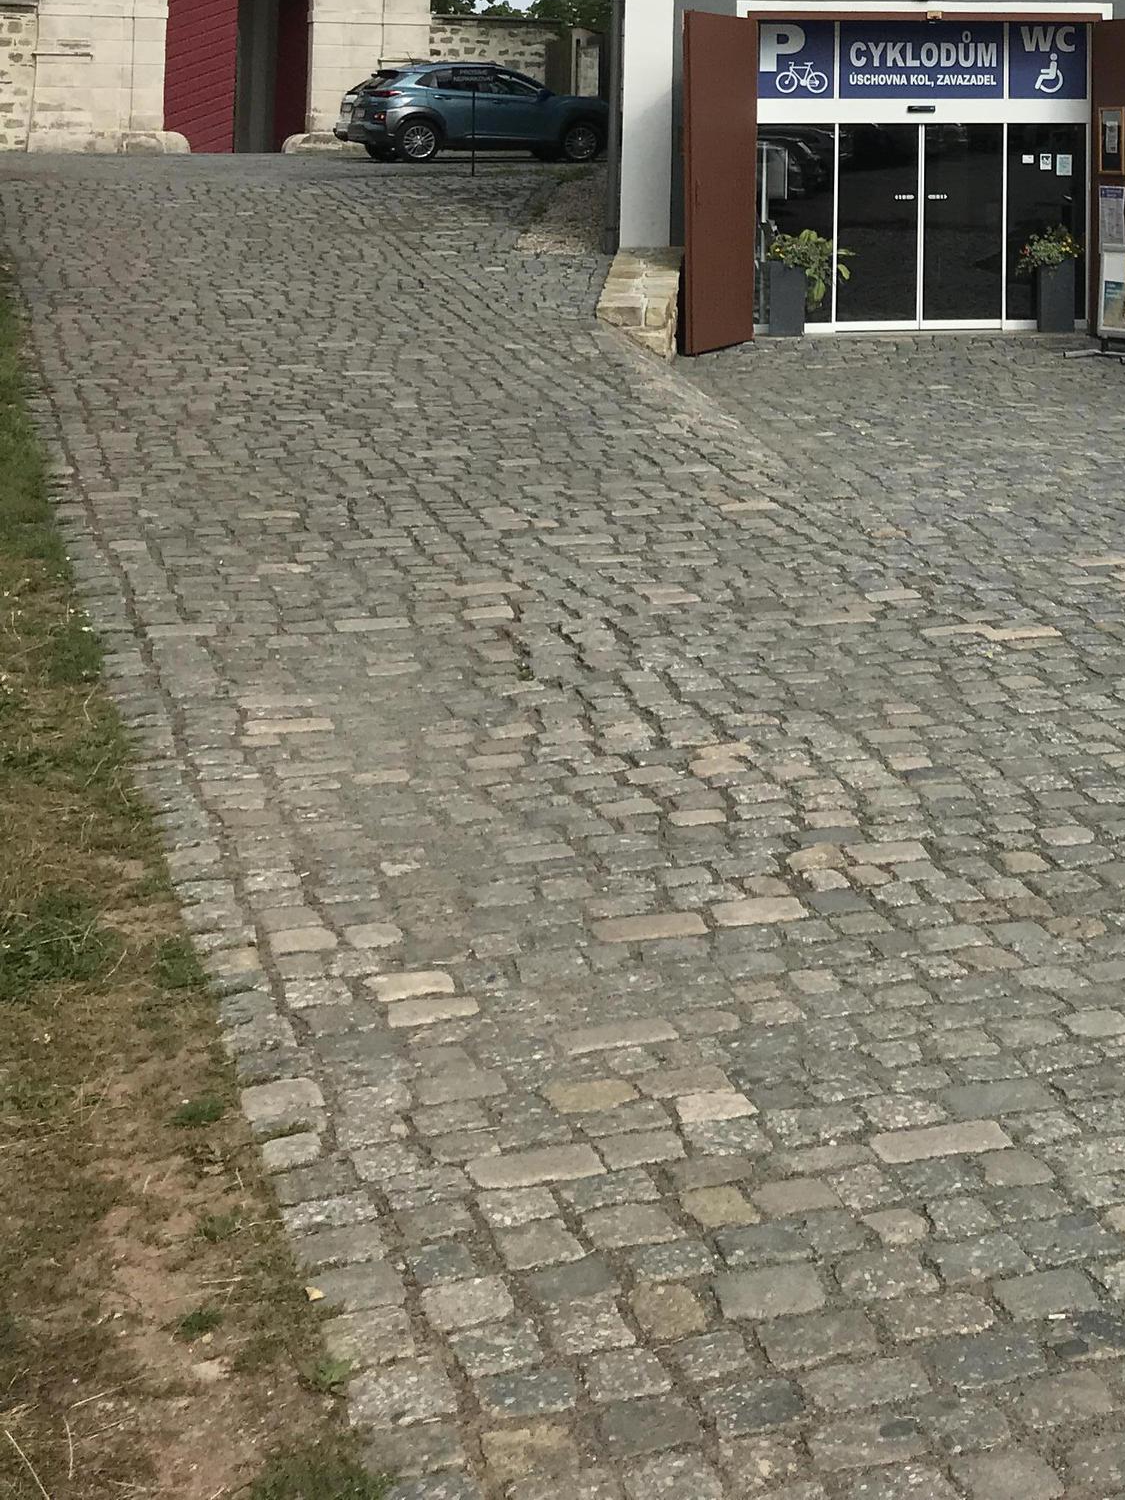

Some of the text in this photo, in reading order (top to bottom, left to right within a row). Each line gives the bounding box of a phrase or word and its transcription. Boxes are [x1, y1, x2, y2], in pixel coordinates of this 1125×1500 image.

[759, 23, 806, 72] P
[849, 30, 997, 68] CYKLODŮM
[1020, 25, 1076, 53] WC
[849, 72, 997, 88] ÚSCHOVNA KOL, ZAVAZADEL
